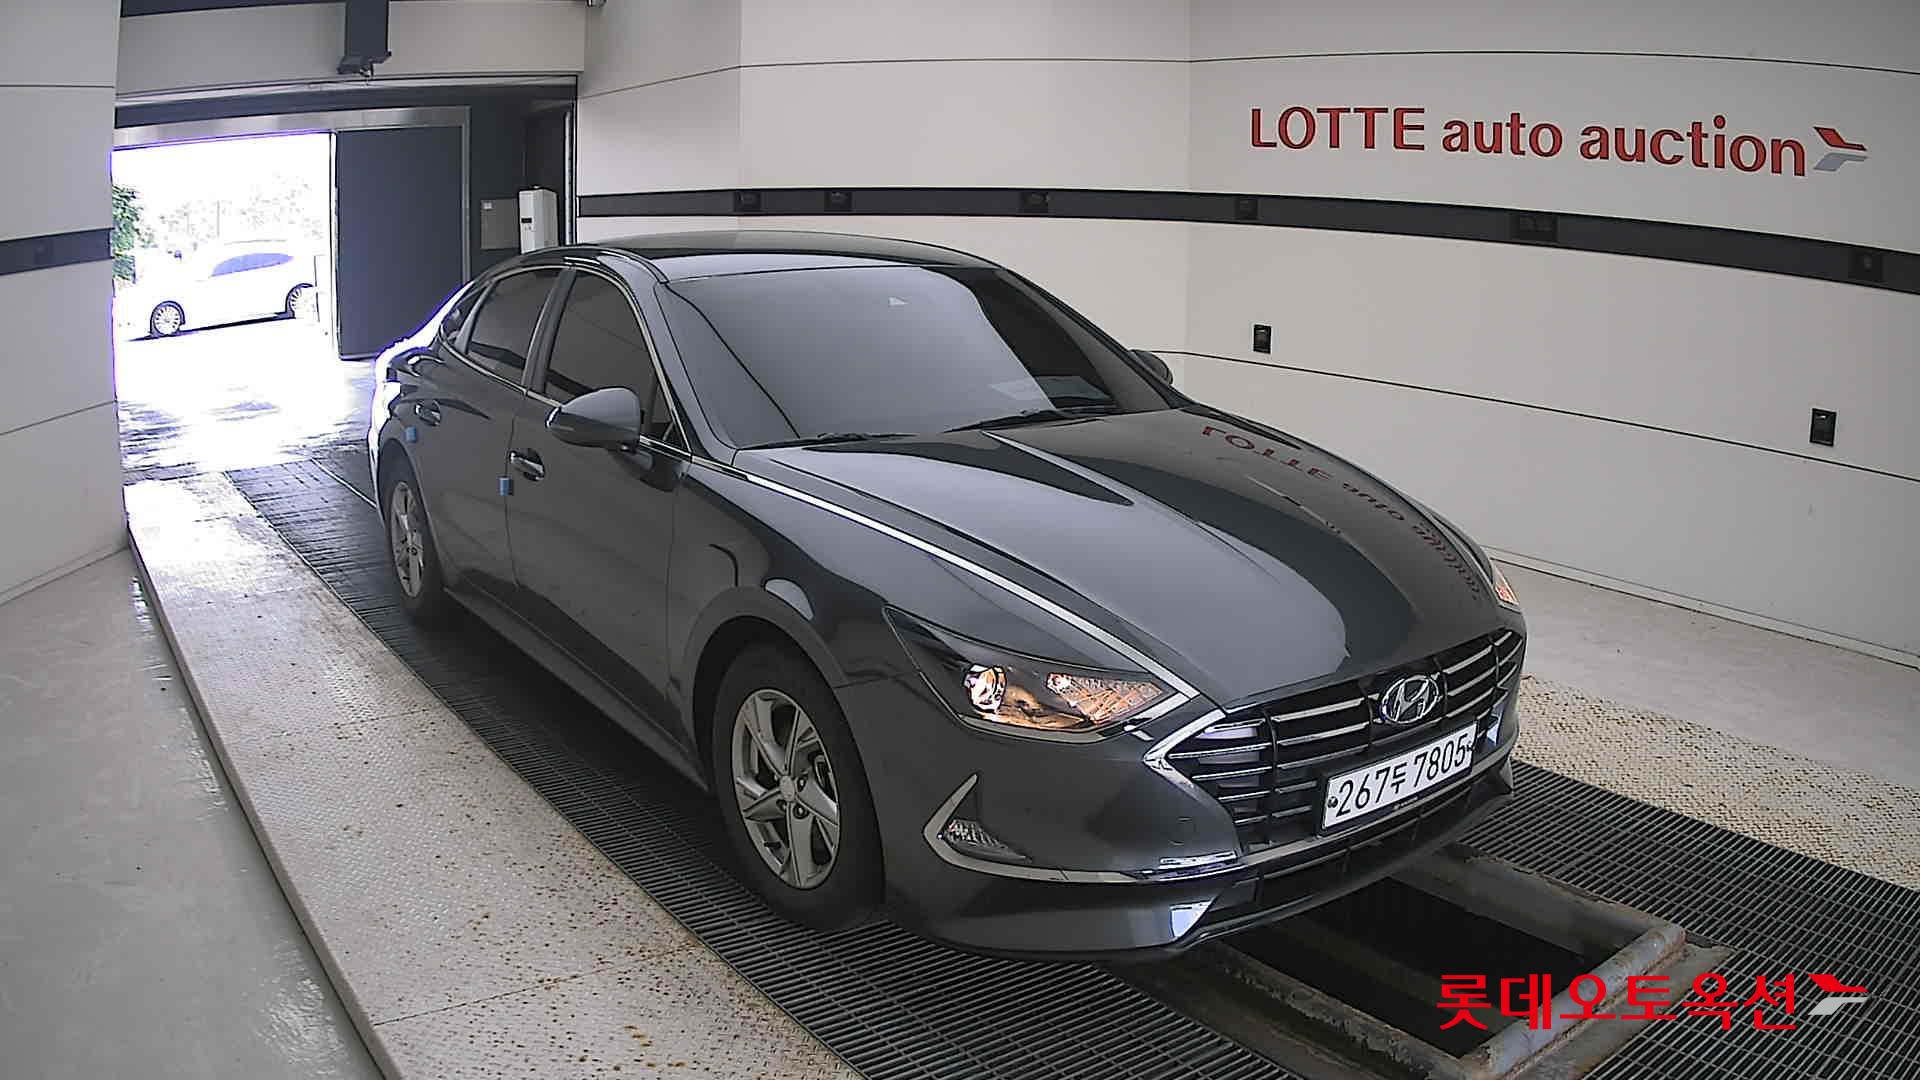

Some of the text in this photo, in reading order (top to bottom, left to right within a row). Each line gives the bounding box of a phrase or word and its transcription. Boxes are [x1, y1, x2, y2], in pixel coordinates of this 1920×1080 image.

[1250, 106, 1806, 177] LOTTE auto auction
[1336, 733, 1468, 818] 267두 7805
